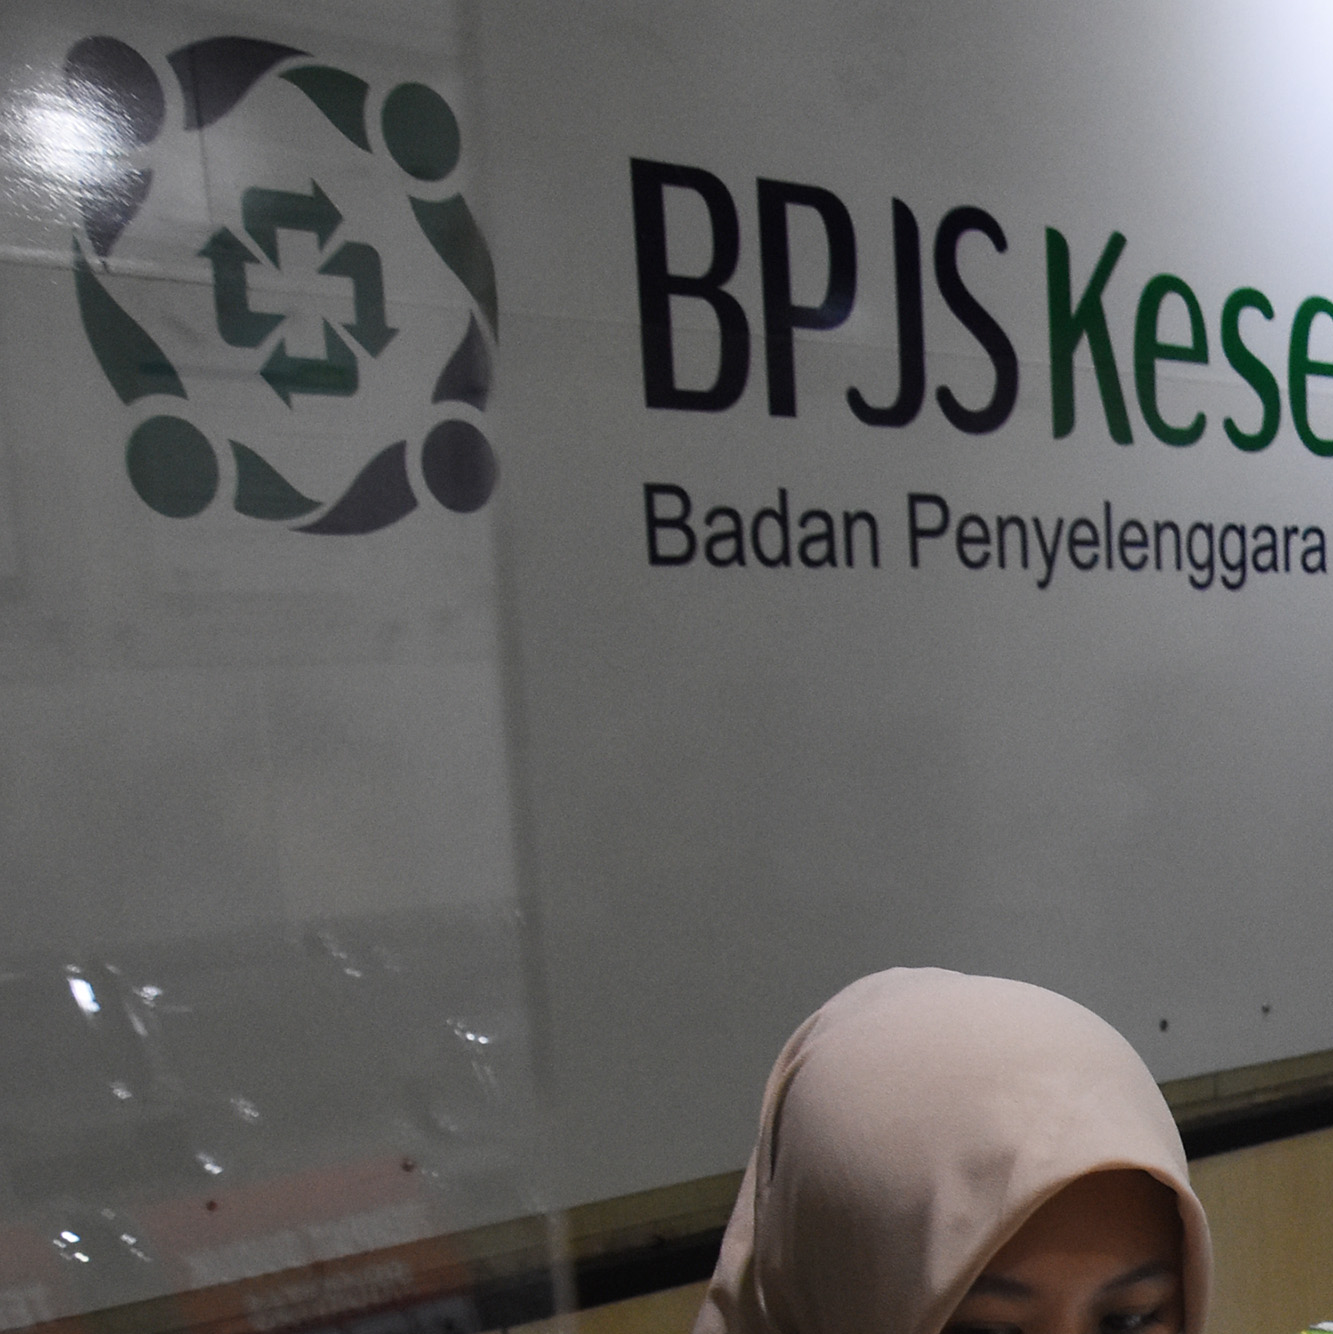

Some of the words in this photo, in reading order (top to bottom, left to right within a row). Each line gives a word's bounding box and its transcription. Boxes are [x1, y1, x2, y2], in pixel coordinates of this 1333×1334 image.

[629, 156, 1020, 435] BPJS
[643, 482, 880, 571] Badan
[906, 492, 1328, 591] Penyelenggara
